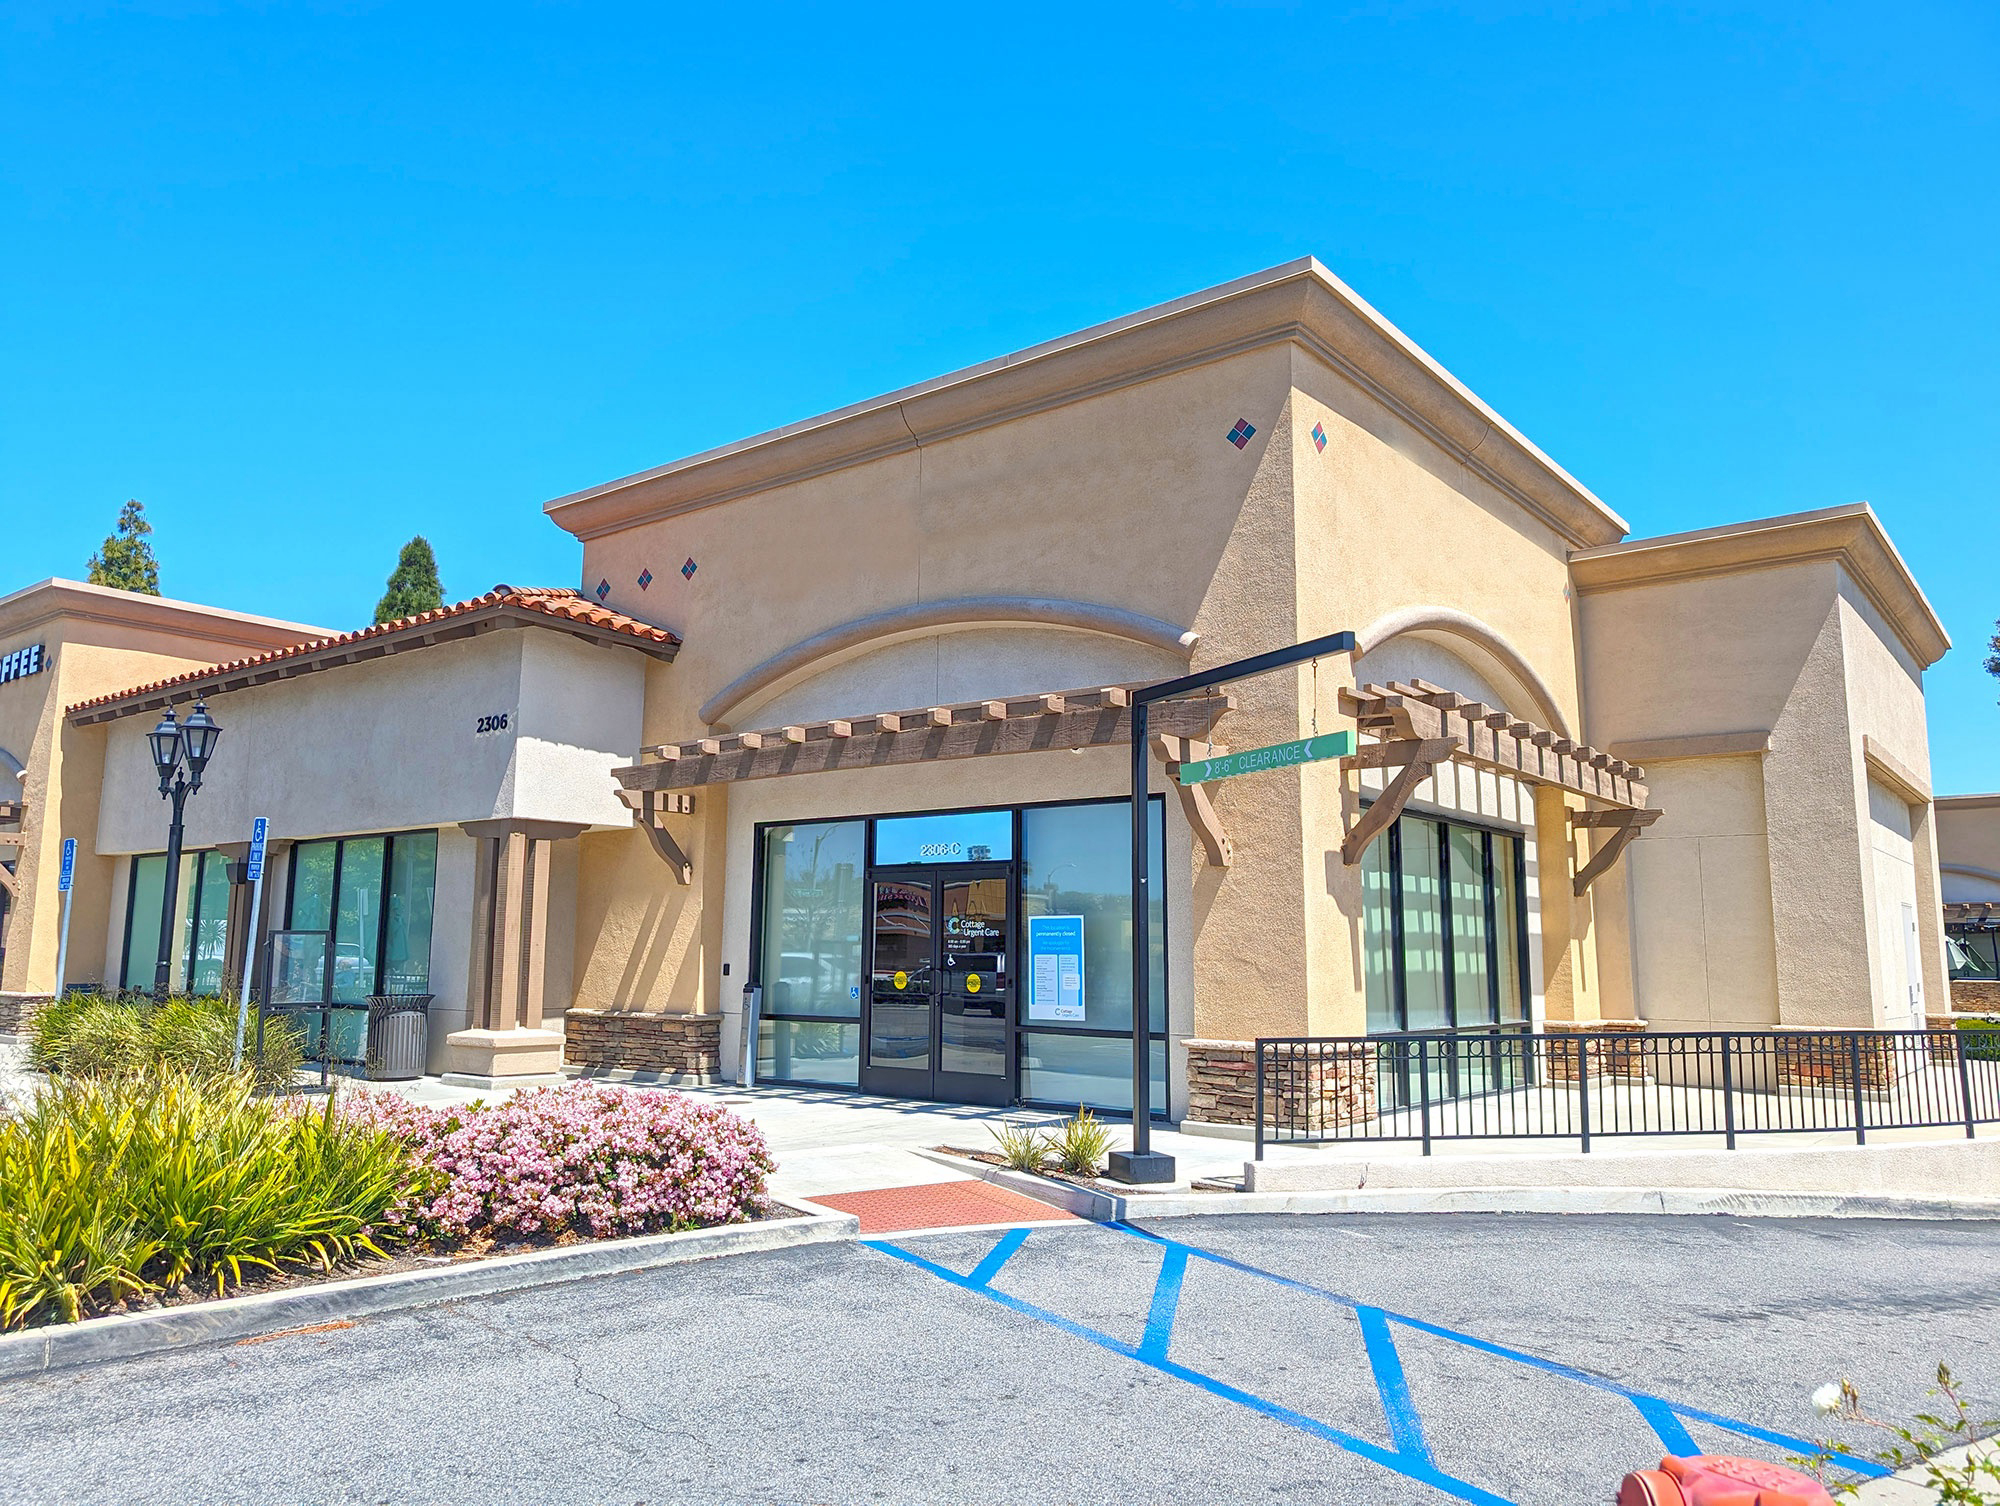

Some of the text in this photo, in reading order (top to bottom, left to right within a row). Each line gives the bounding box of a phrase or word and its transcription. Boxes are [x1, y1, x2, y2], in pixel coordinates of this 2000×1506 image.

[0, 644, 41, 684] FFEE
[476, 713, 508, 733] 2306
[1238, 745, 1300, 770] CLEARANCE
[920, 842, 961, 856] 2306-C
[960, 920, 985, 929] Cottage
[963, 928, 1000, 937] Urgent Care
